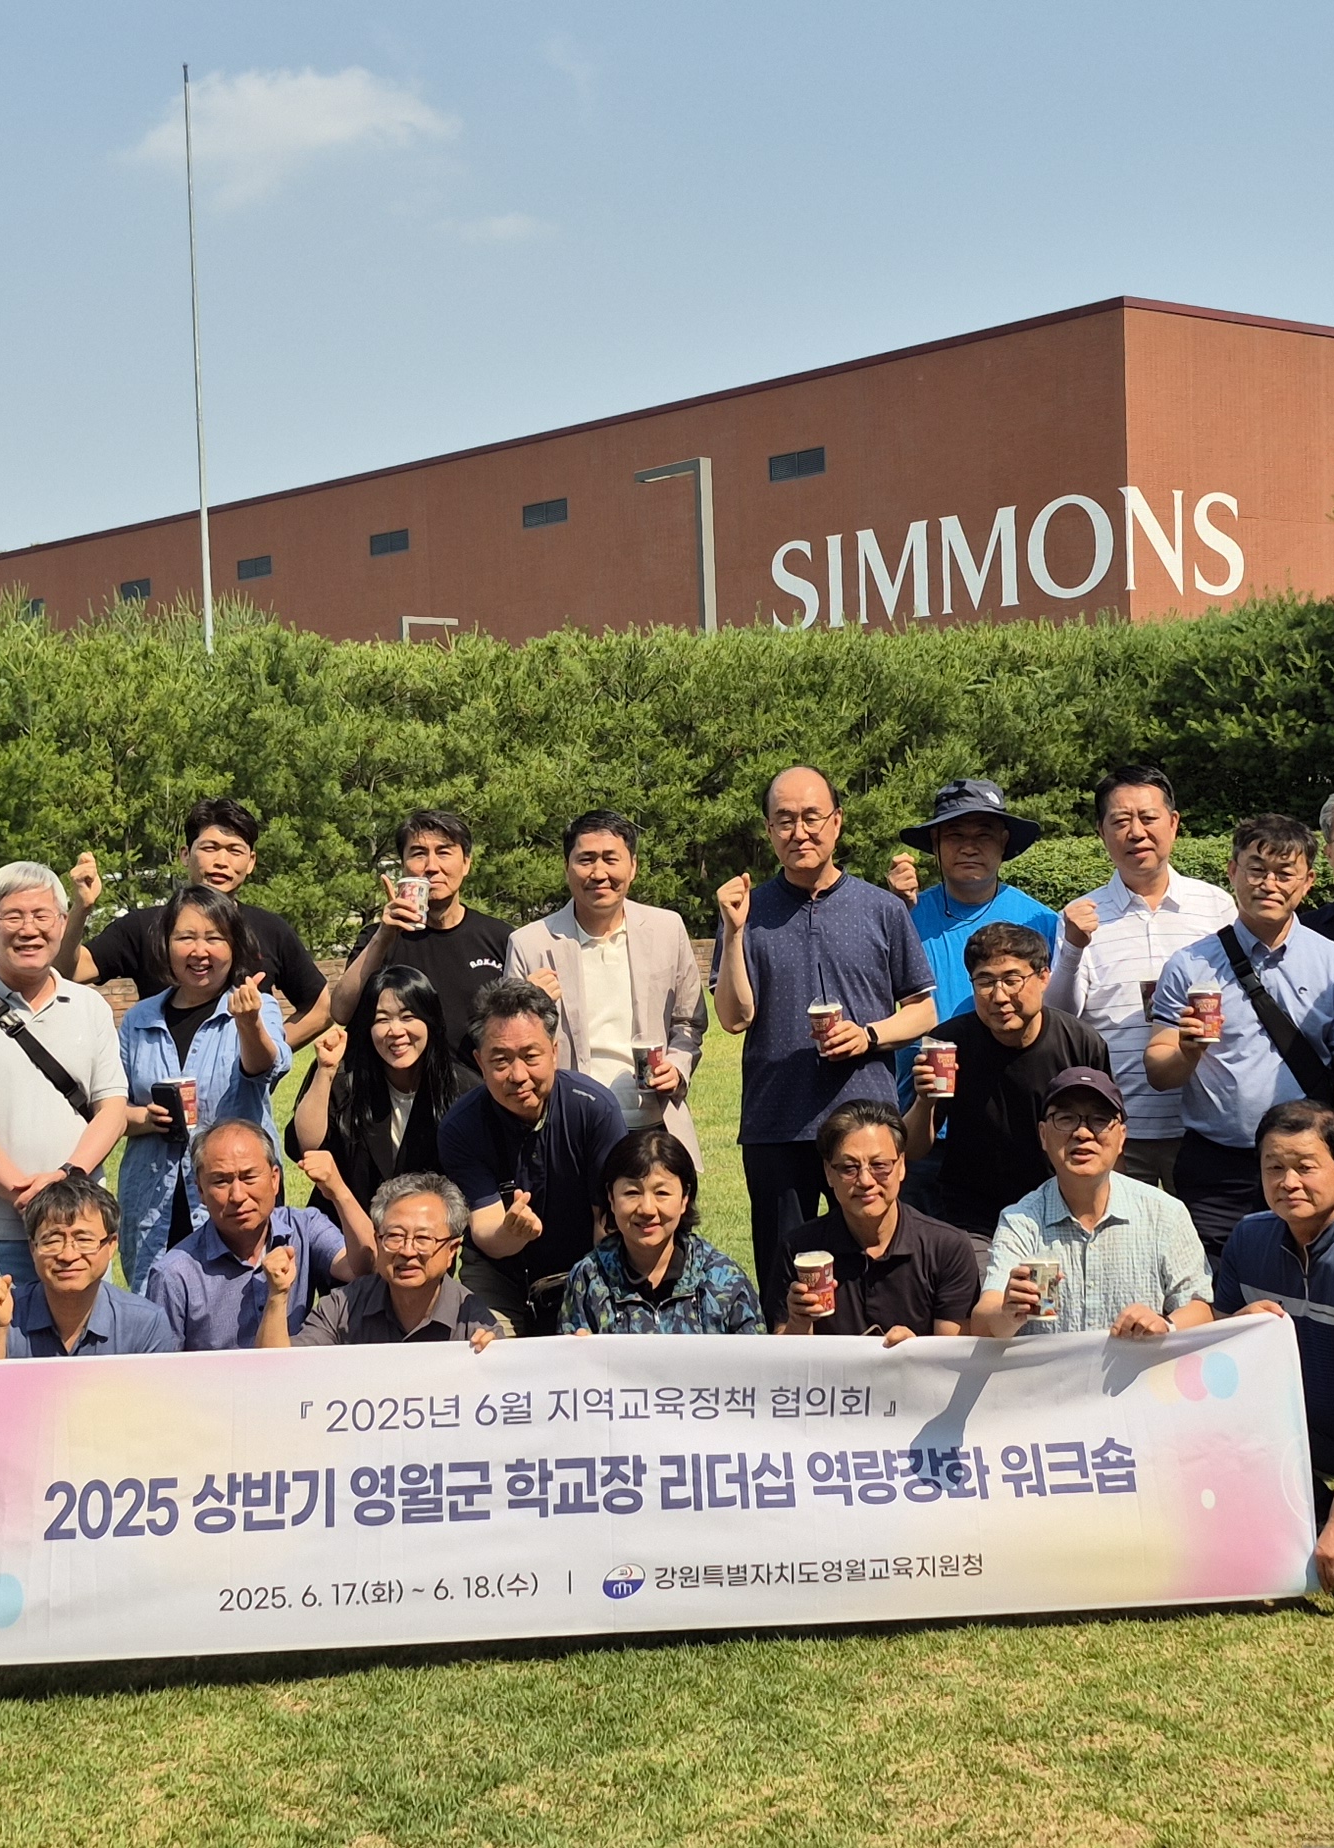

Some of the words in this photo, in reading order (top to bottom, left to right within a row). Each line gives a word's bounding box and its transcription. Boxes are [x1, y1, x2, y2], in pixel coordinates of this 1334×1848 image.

[771, 486, 1244, 630] SIMMONS
[325, 1394, 460, 1432] 2025년
[475, 1390, 532, 1426] 6월
[547, 1386, 756, 1422] 지역교육정책
[770, 1385, 871, 1419] 협의회
[44, 1477, 179, 1541] 2025
[192, 1468, 336, 1534] 상반기
[350, 1462, 493, 1525] 영월군
[505, 1455, 647, 1519] 학교장
[660, 1450, 797, 1512] 리더십
[806, 1446, 990, 1507] 역량강화
[1000, 1437, 1137, 1498] 워크숍
[219, 1586, 293, 1612] 2025.
[301, 1585, 323, 1608] 6.
[331, 1579, 404, 1606] 17.(화)
[433, 1577, 455, 1601] 6.
[463, 1571, 539, 1599] 18.(수)
[654, 1552, 984, 1591] 강원특별자치도영월교육지원청
